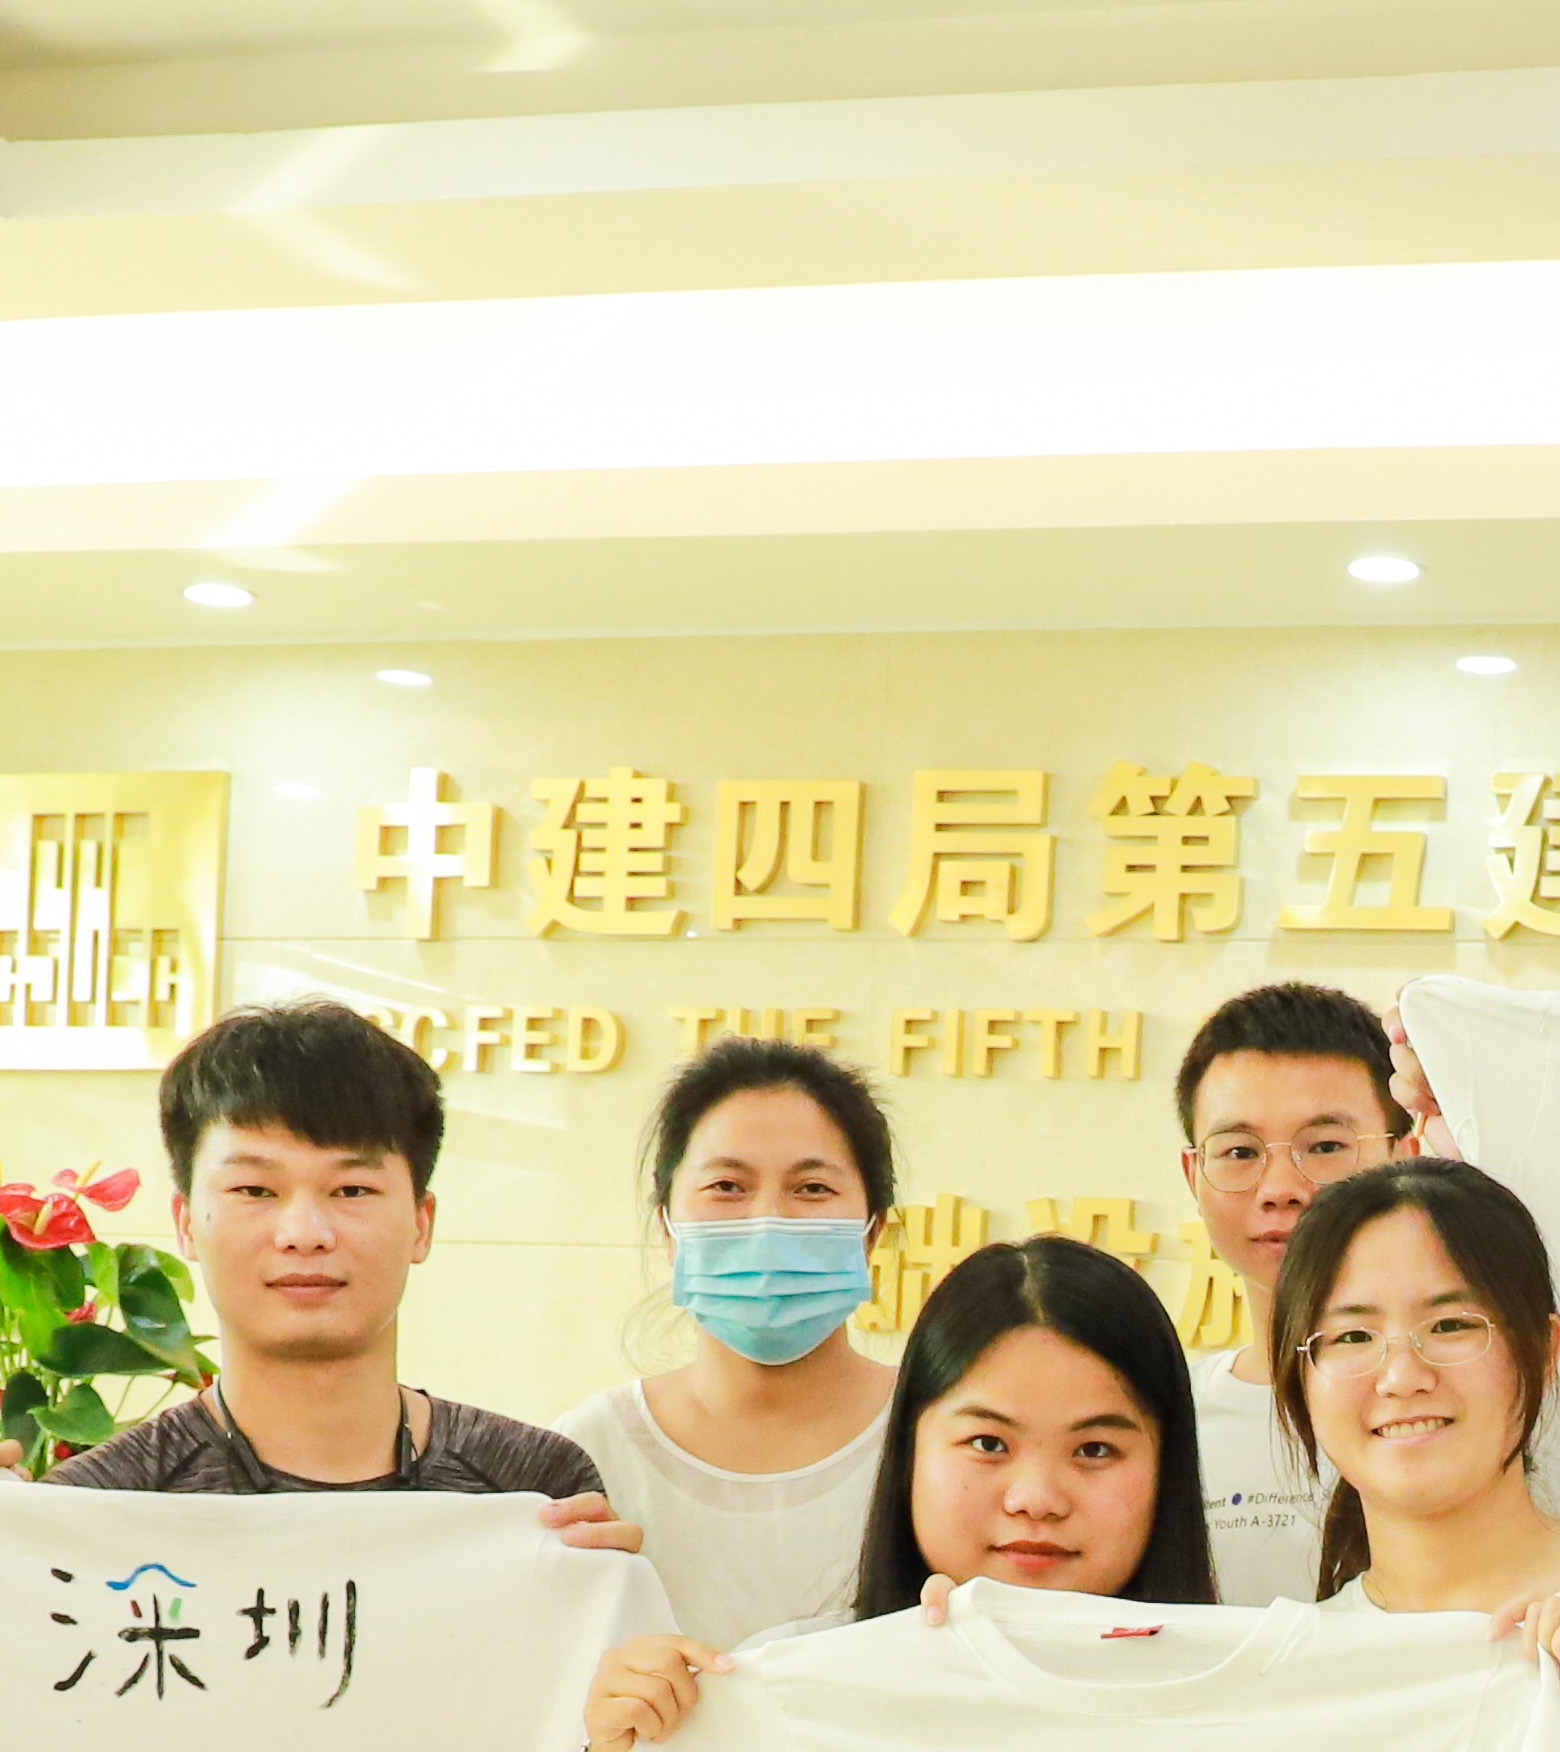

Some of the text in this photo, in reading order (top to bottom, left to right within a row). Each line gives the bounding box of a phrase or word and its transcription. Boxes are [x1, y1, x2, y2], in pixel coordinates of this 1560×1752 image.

[360, 1004, 628, 1074] CFED
[890, 1007, 1144, 1081] FIFTH
[1214, 1514, 1297, 1530] Youth A-3721
[49, 1560, 359, 1709] 深圳
